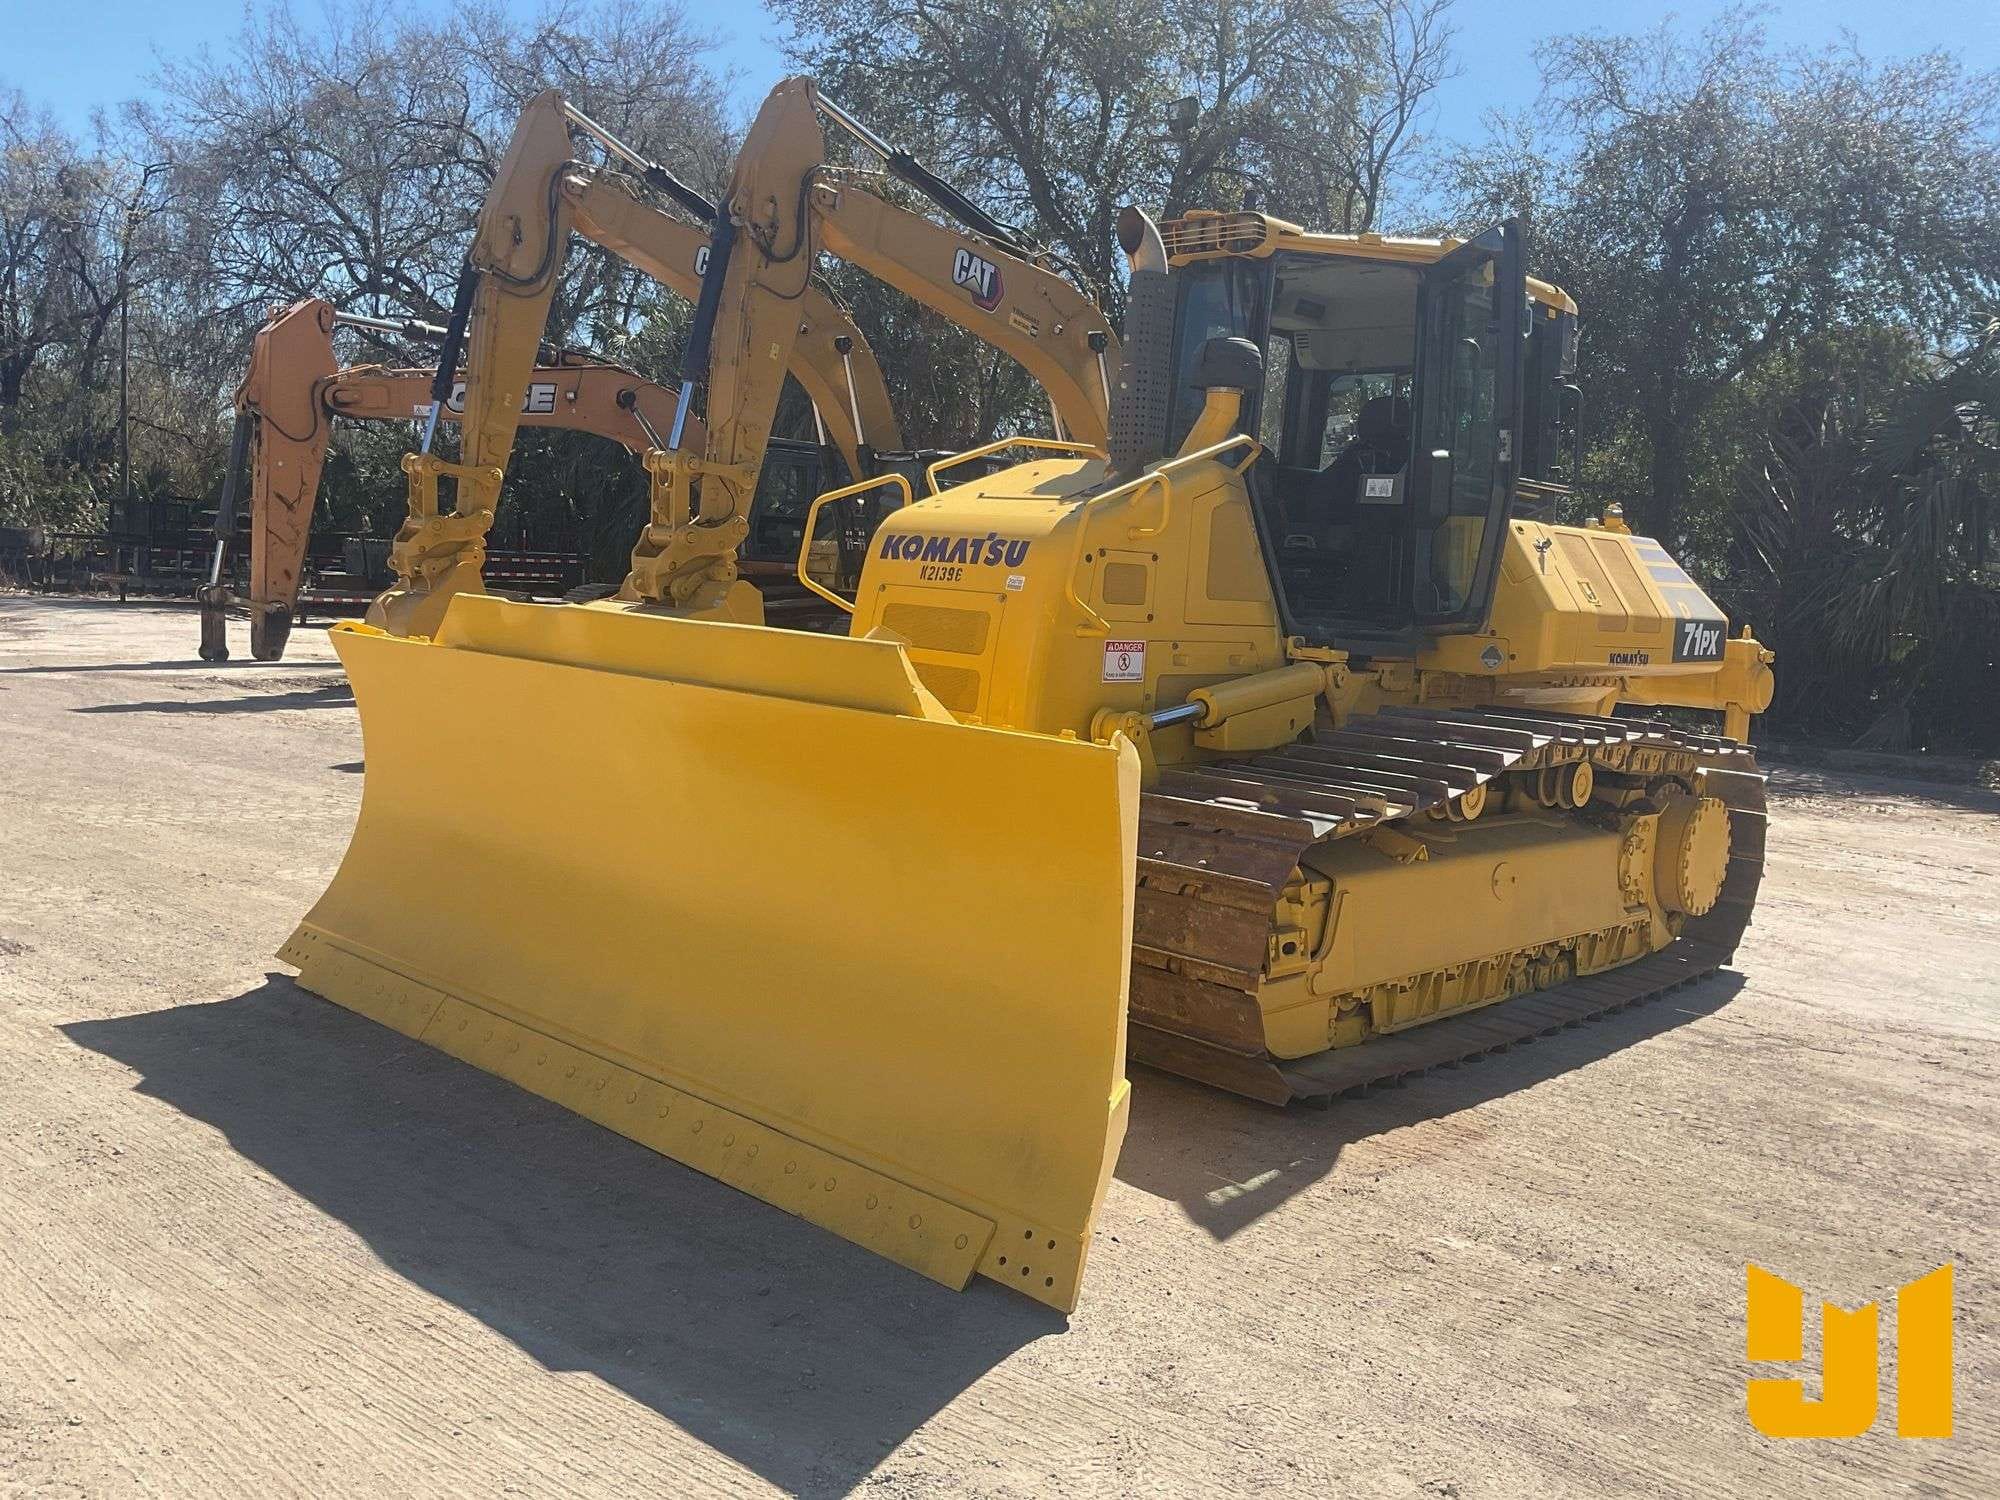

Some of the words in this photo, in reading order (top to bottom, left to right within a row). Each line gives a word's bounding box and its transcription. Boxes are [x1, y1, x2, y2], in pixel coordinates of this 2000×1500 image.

[953, 248, 995, 298] CAT
[879, 532, 1031, 568] KOMATSU
[1114, 642, 1143, 651] DANGER
[1682, 622, 1720, 656] 71PX
[1609, 649, 1649, 664] KOMATSU
